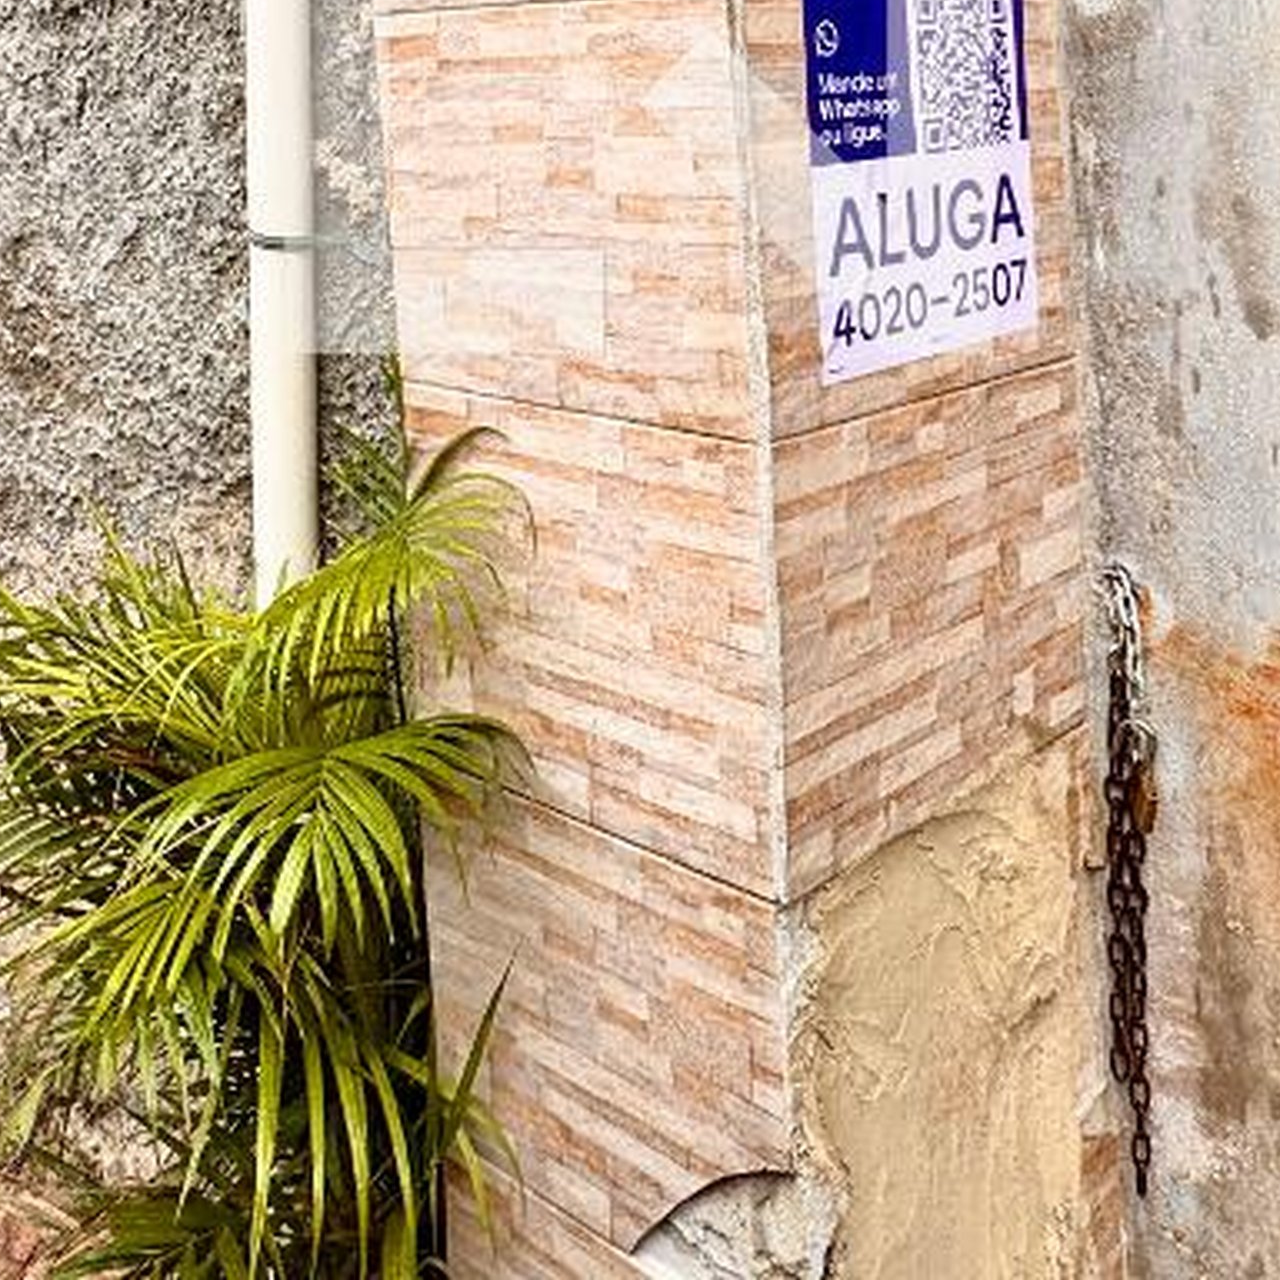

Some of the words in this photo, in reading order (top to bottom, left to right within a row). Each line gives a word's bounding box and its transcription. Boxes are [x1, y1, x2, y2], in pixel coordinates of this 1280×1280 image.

[819, 129, 841, 147] ou
[829, 173, 1025, 277] ALUGA
[833, 258, 1028, 348] 4020-2507
